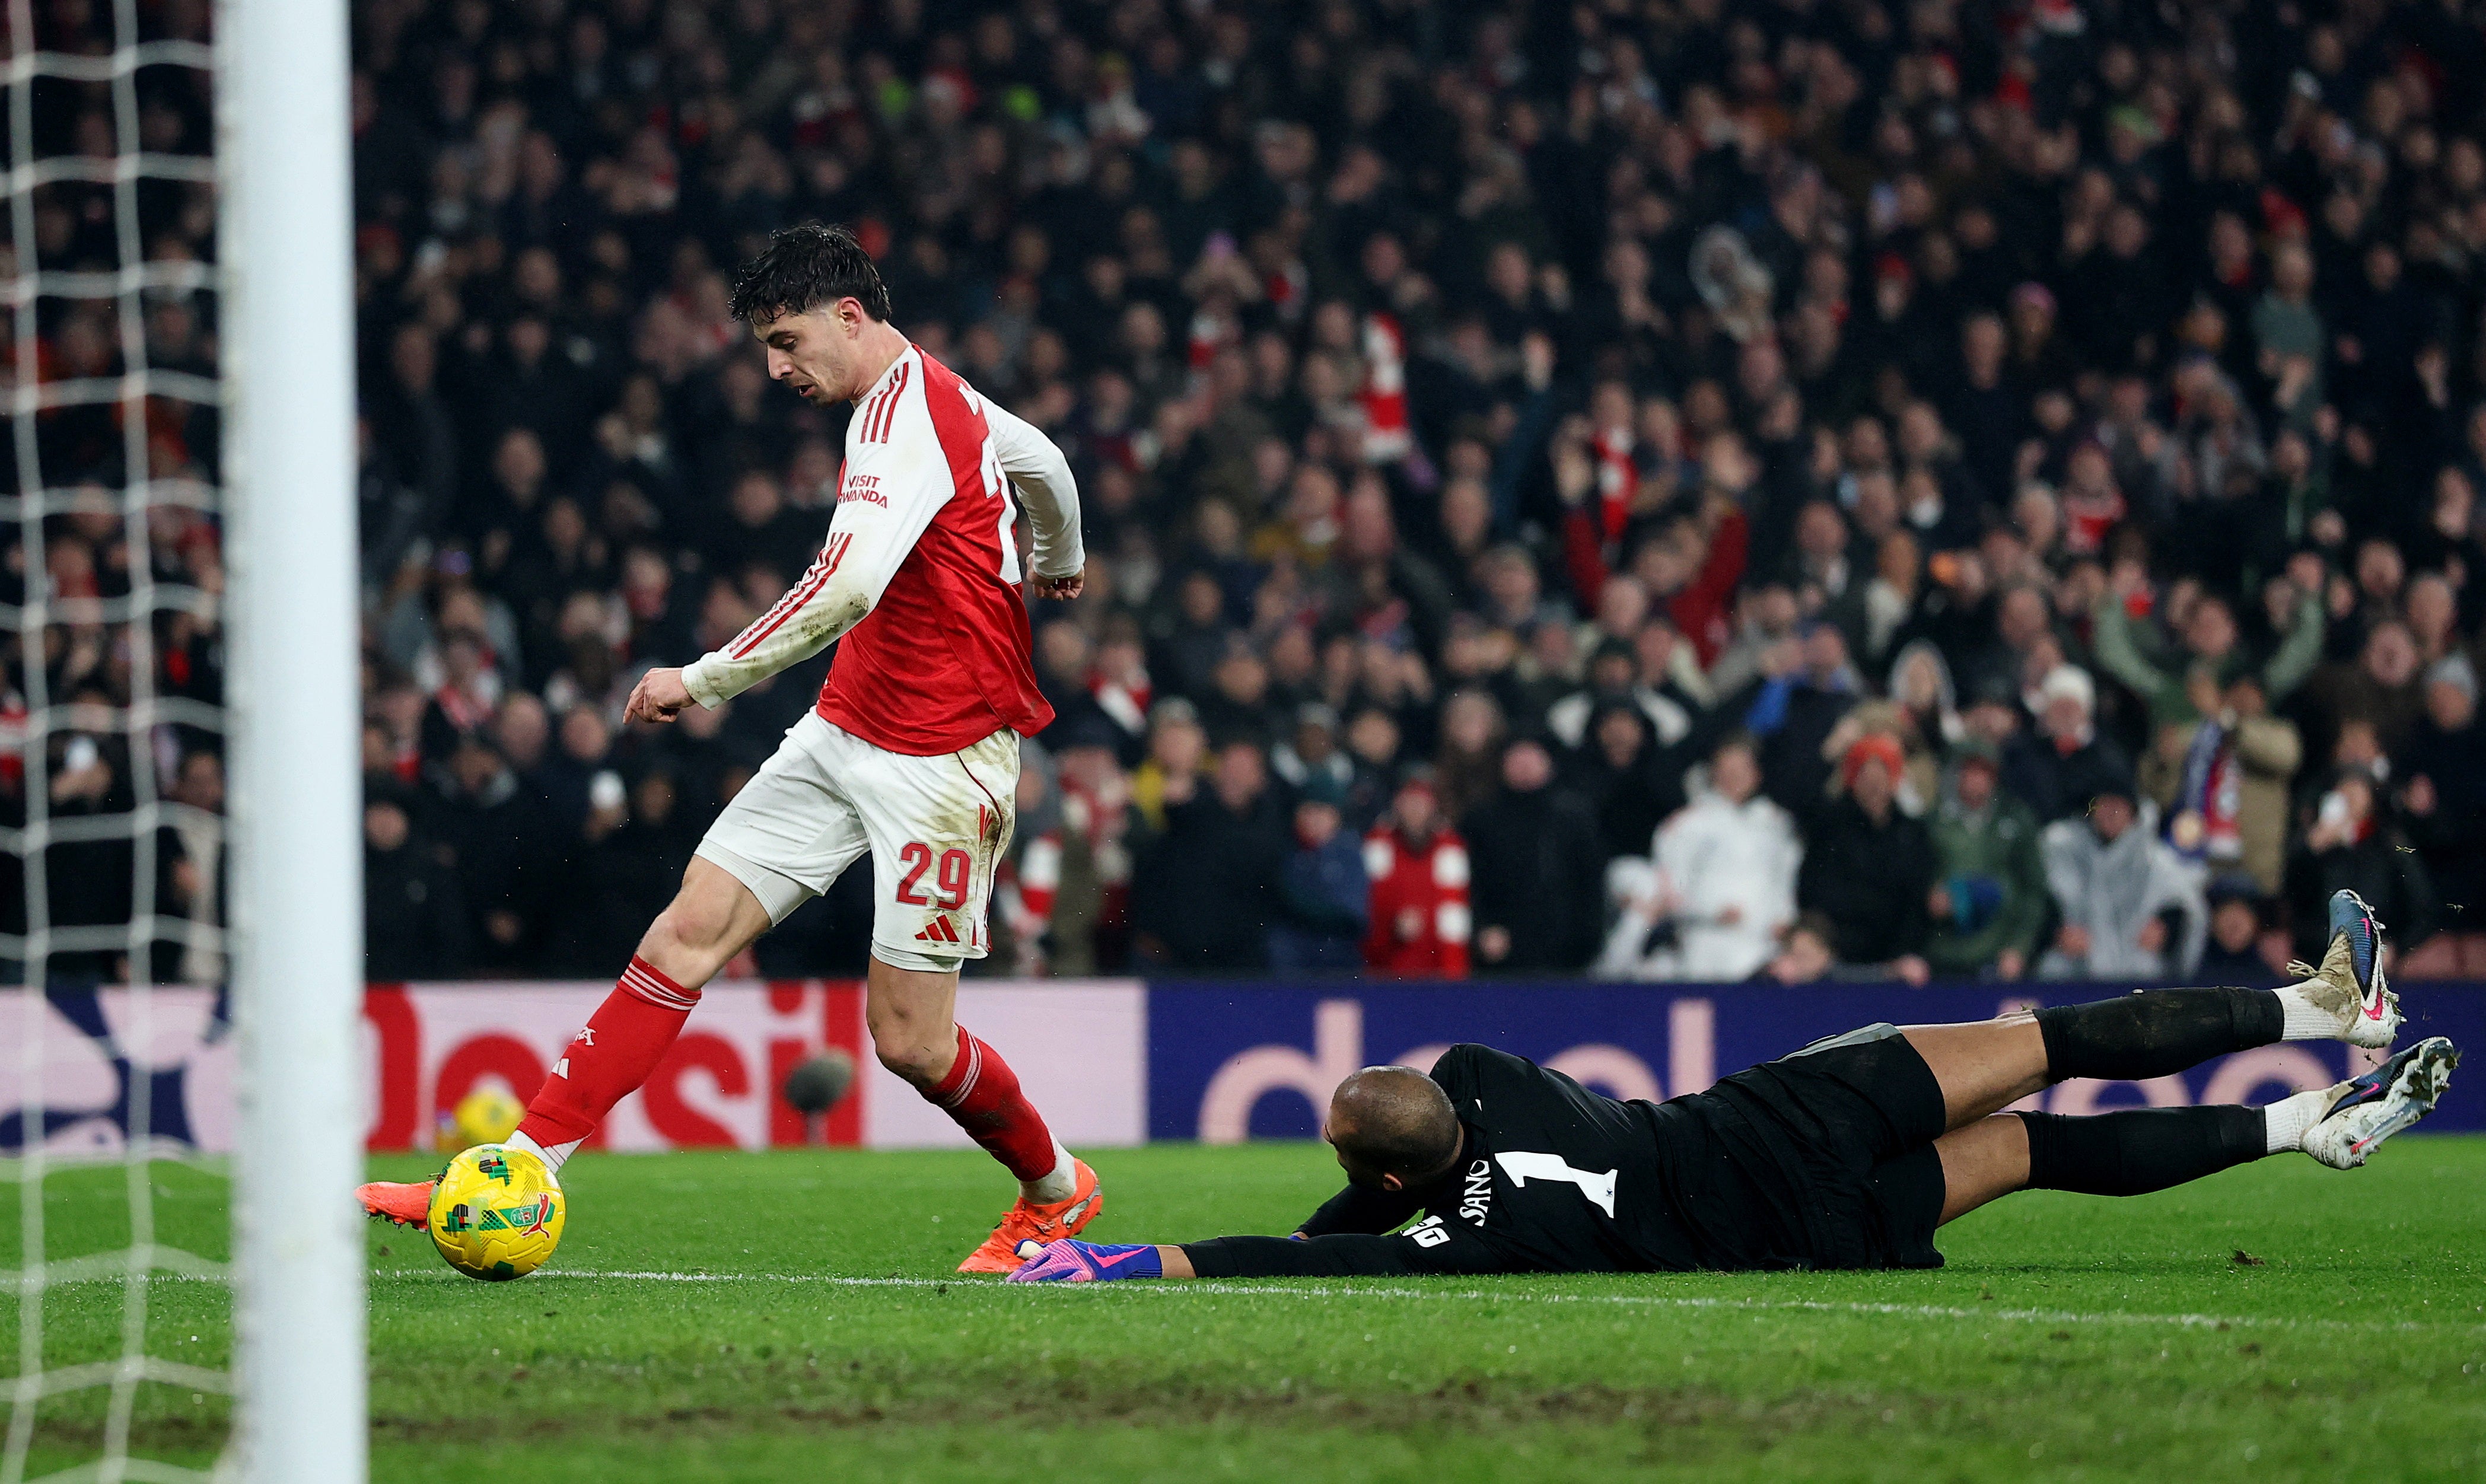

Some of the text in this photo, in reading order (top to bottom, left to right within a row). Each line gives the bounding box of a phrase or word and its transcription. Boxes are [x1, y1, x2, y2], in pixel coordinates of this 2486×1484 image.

[838, 489, 887, 509] RWANDA
[849, 475, 880, 488] VISIT
[896, 840, 972, 912] 29
[1494, 1151, 1618, 1219] 1
